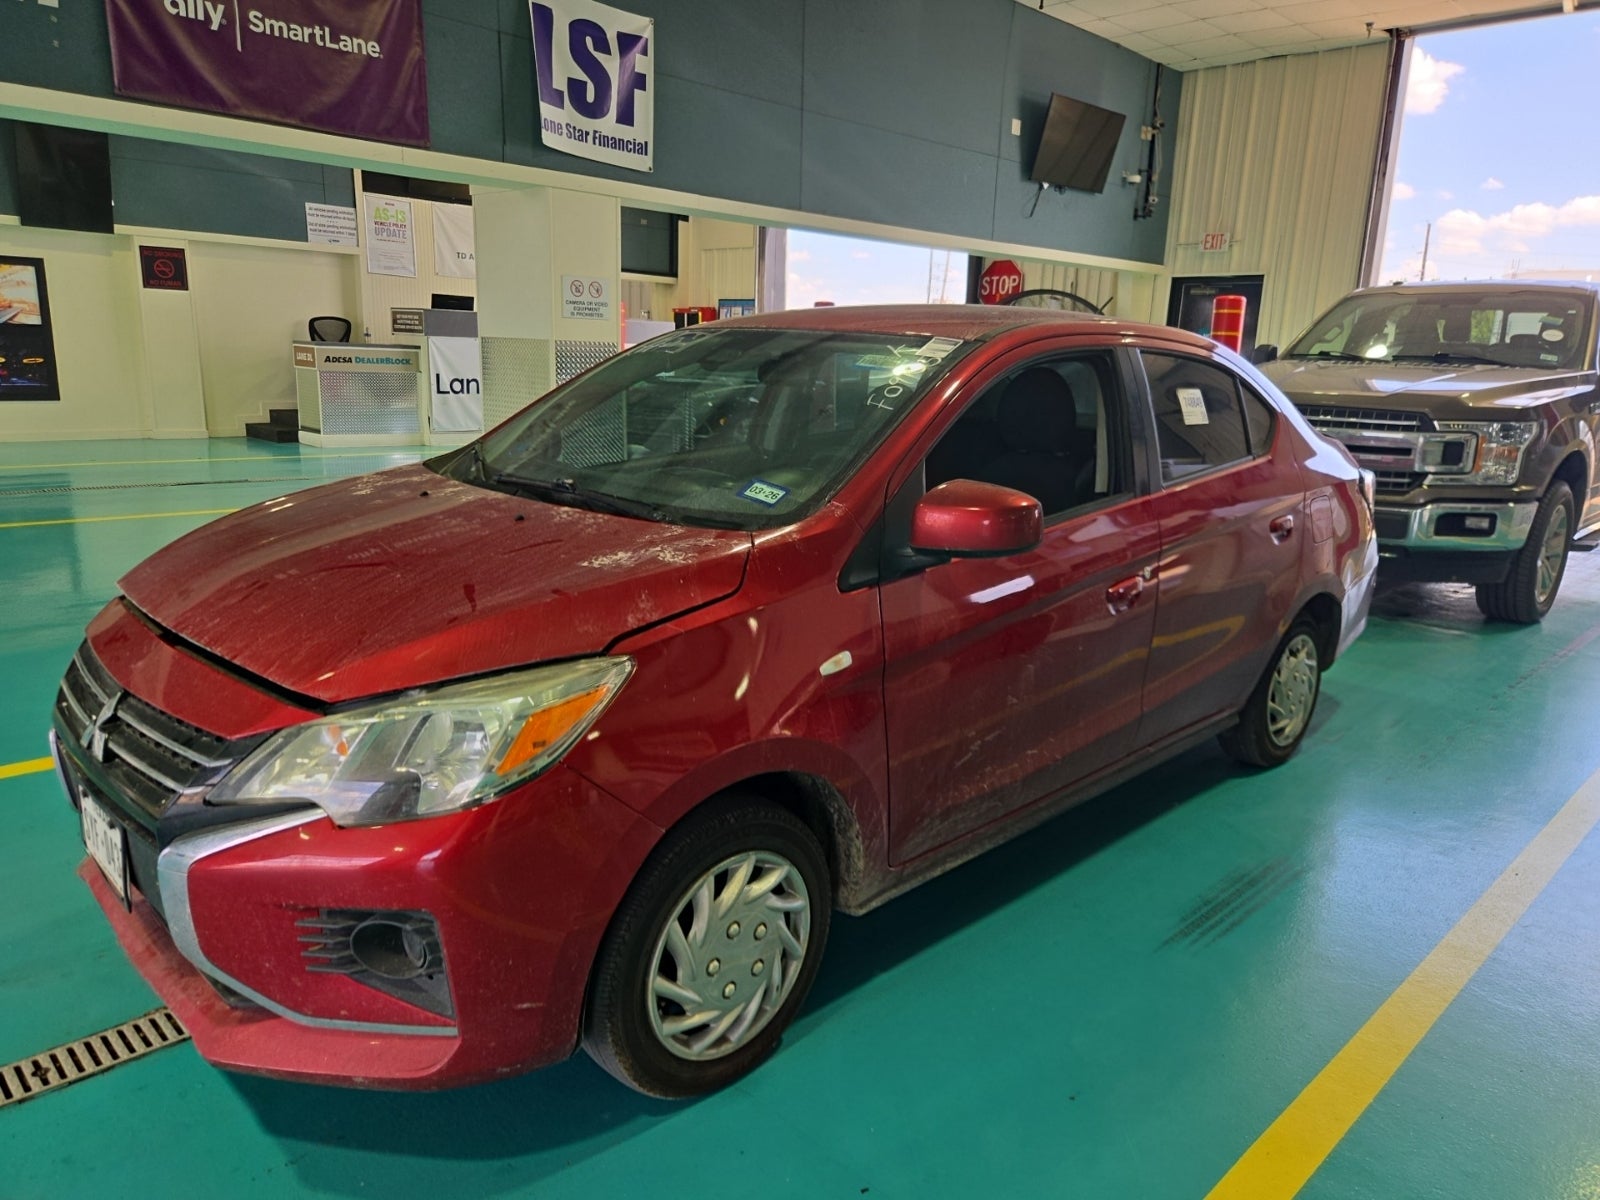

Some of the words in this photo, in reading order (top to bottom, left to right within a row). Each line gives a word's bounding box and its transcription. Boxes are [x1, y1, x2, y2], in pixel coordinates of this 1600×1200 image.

[531, 2, 649, 127] LSF
[565, 122, 590, 144] Star
[592, 129, 649, 156] Financial
[373, 206, 407, 223] AS-IS
[374, 227, 408, 240] UPDATE
[1204, 234, 1224, 250] EXIT
[981, 275, 1020, 296] STOP
[324, 355, 353, 364] ADESA
[435, 372, 480, 395] Lan
